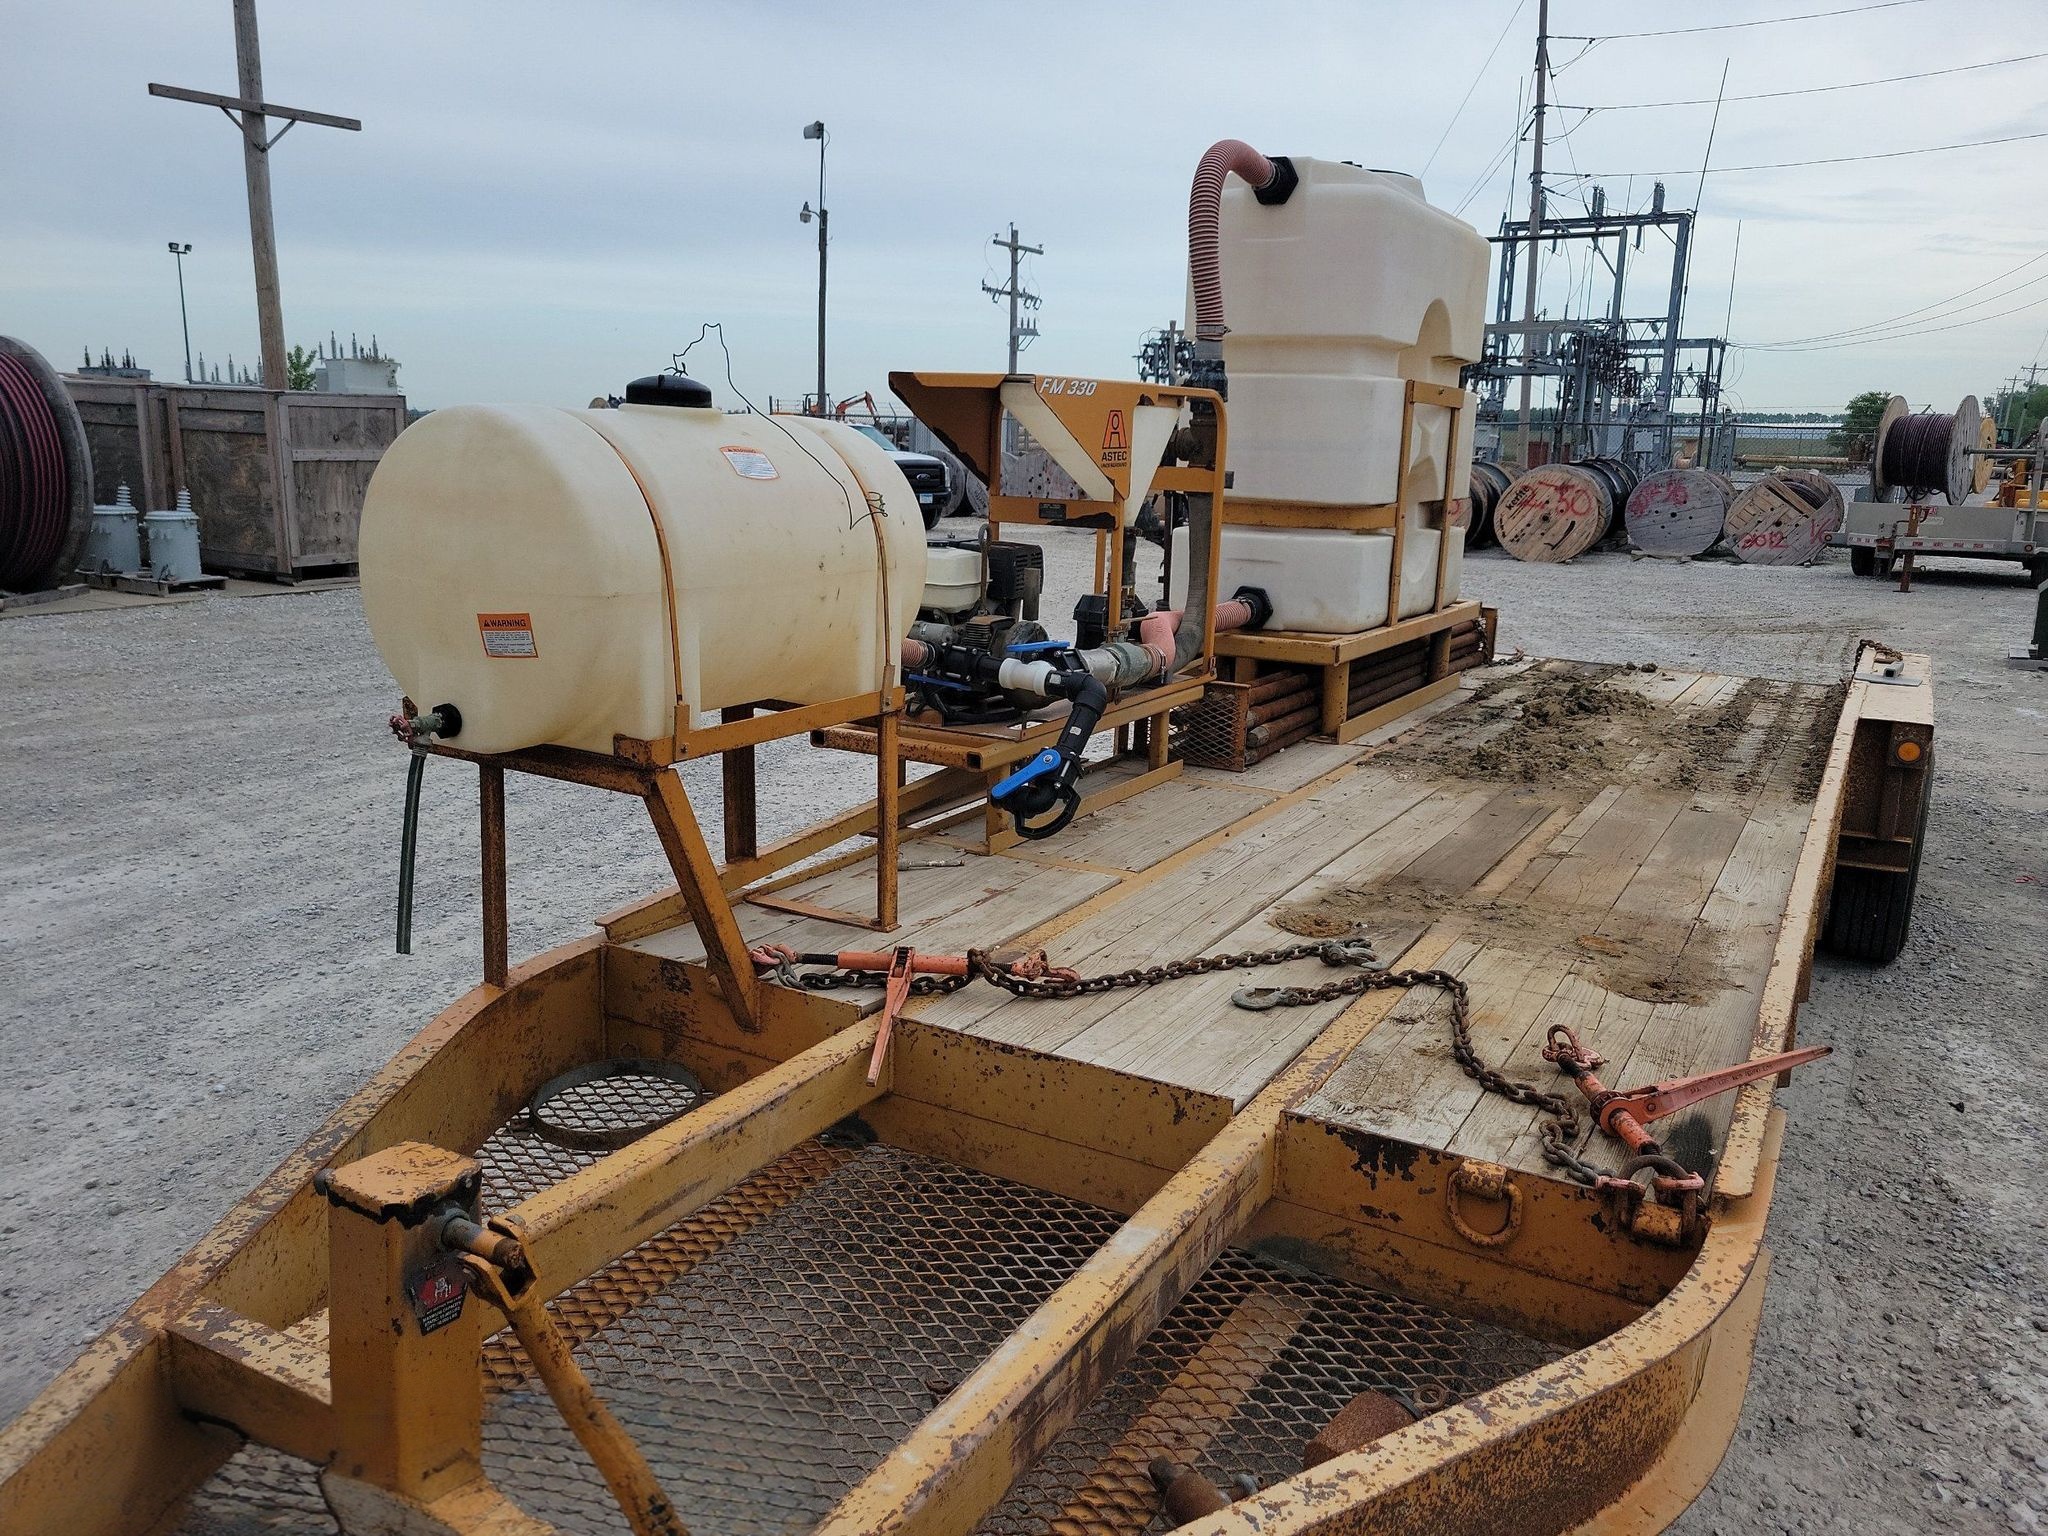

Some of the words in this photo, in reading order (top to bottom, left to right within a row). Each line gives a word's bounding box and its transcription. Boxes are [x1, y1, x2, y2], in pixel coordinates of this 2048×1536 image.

[1039, 378, 1066, 395] FM
[1067, 380, 1097, 396] 330
[1101, 451, 1127, 462] ASTEC
[489, 619, 527, 627] WARNING
